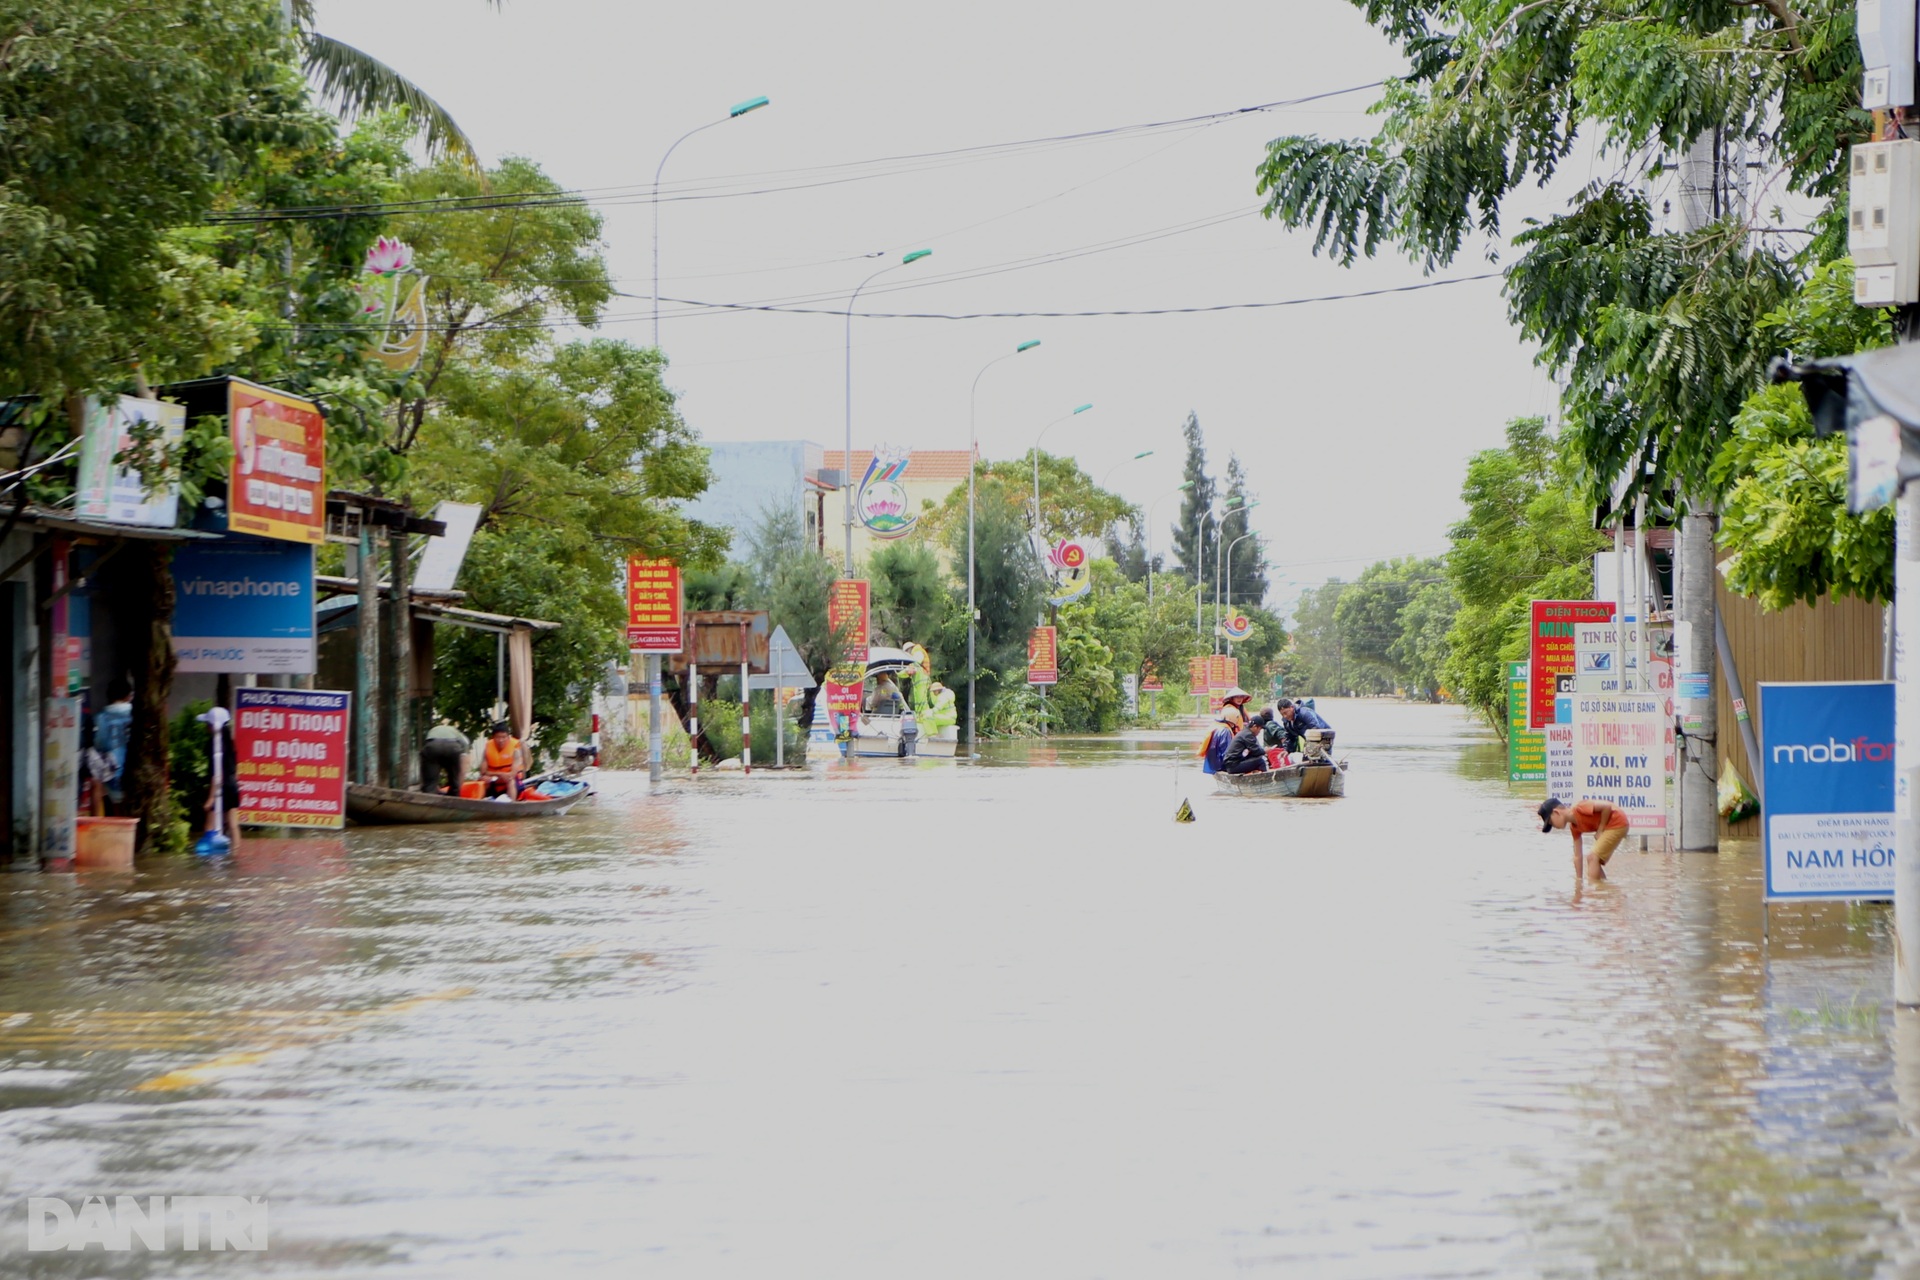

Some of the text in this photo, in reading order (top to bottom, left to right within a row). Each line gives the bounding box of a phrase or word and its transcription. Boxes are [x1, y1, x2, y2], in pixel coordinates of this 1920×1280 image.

[181, 576, 301, 599] vinaphone
[1546, 606, 1610, 619] ĐIỆN THOẠI
[1582, 632, 1601, 644] TIN
[1637, 699, 1656, 712] BÁNH
[241, 709, 342, 735] ĐIỆN THOẠI
[253, 738, 327, 762] DI ĐỘNG
[1590, 753, 1619, 769] XÔI,
[1625, 753, 1648, 768] MỲ
[1587, 772, 1651, 788] BÁNH BAO
[1817, 816, 1890, 827] ĐIỂM BÁN HÀNG
[1787, 849, 1844, 869] NAM
